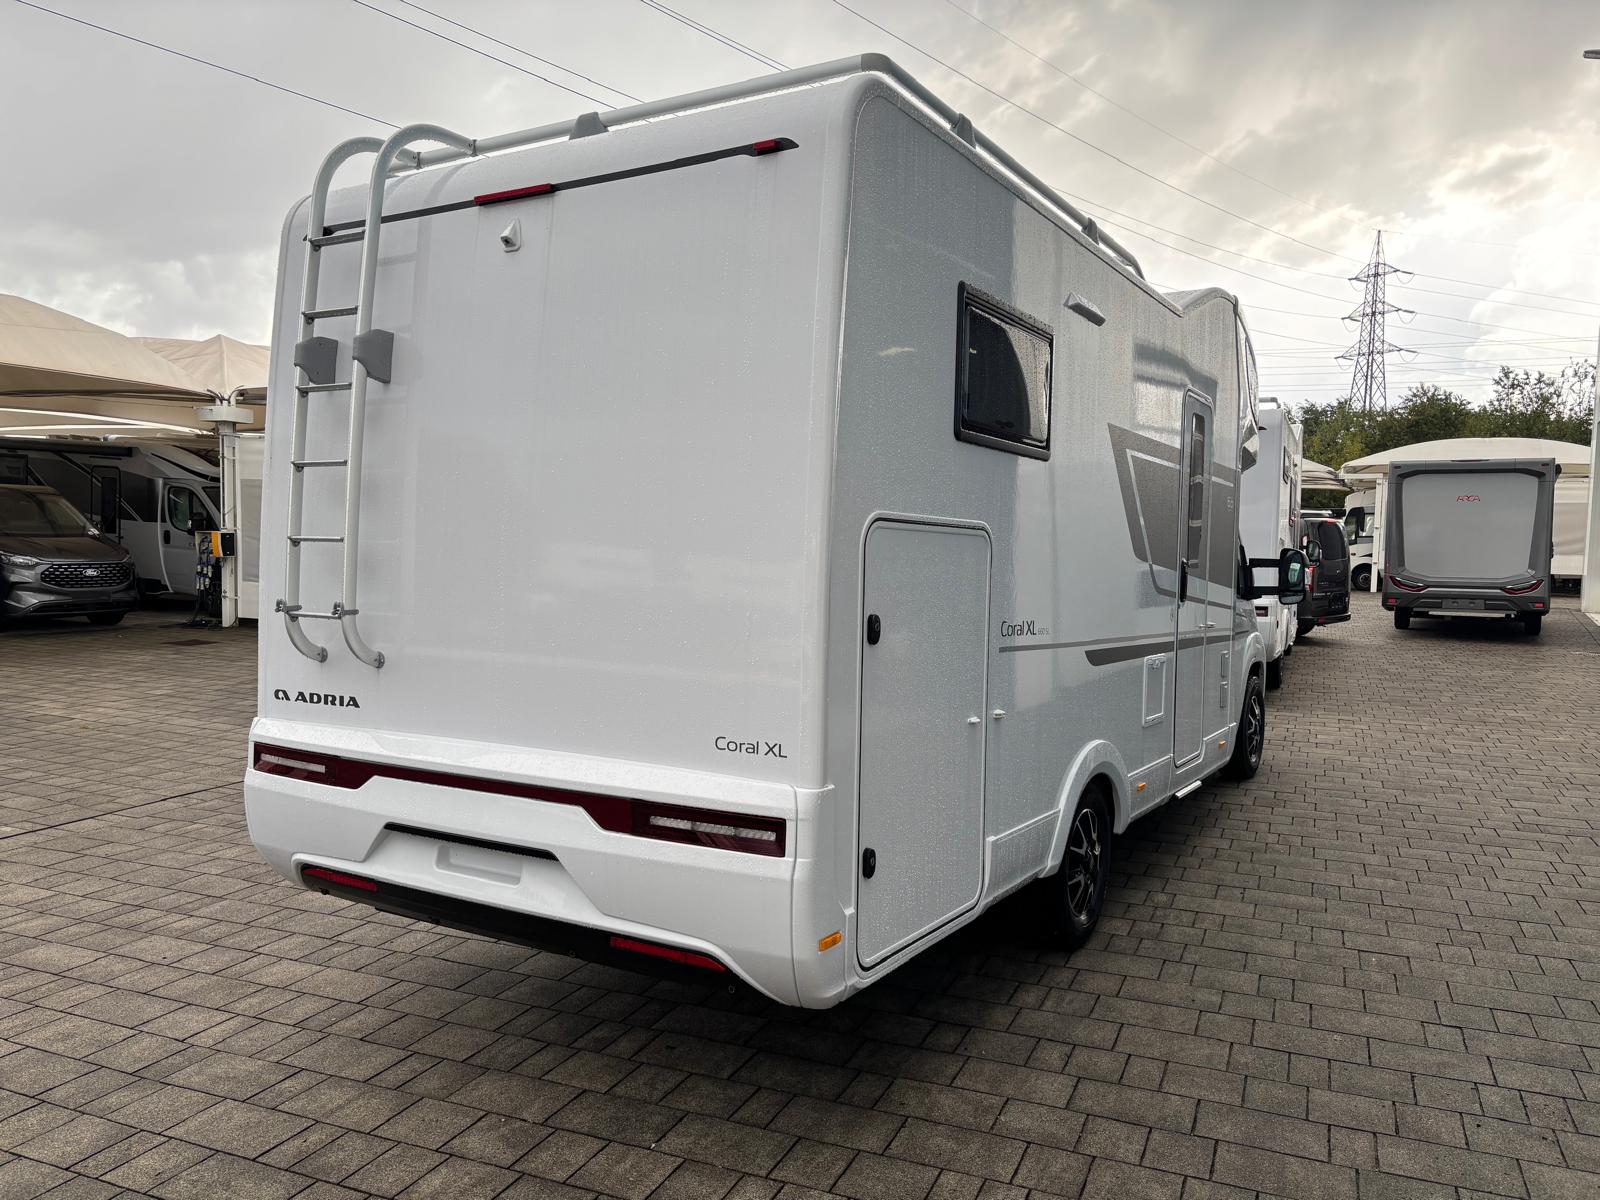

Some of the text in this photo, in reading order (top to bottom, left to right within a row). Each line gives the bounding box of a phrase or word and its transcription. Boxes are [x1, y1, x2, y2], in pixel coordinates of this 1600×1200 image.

[1000, 620, 1025, 637] Coral
[1025, 620, 1037, 636] XL
[294, 691, 361, 709] ADRIA
[715, 736, 788, 759] Coral XL
